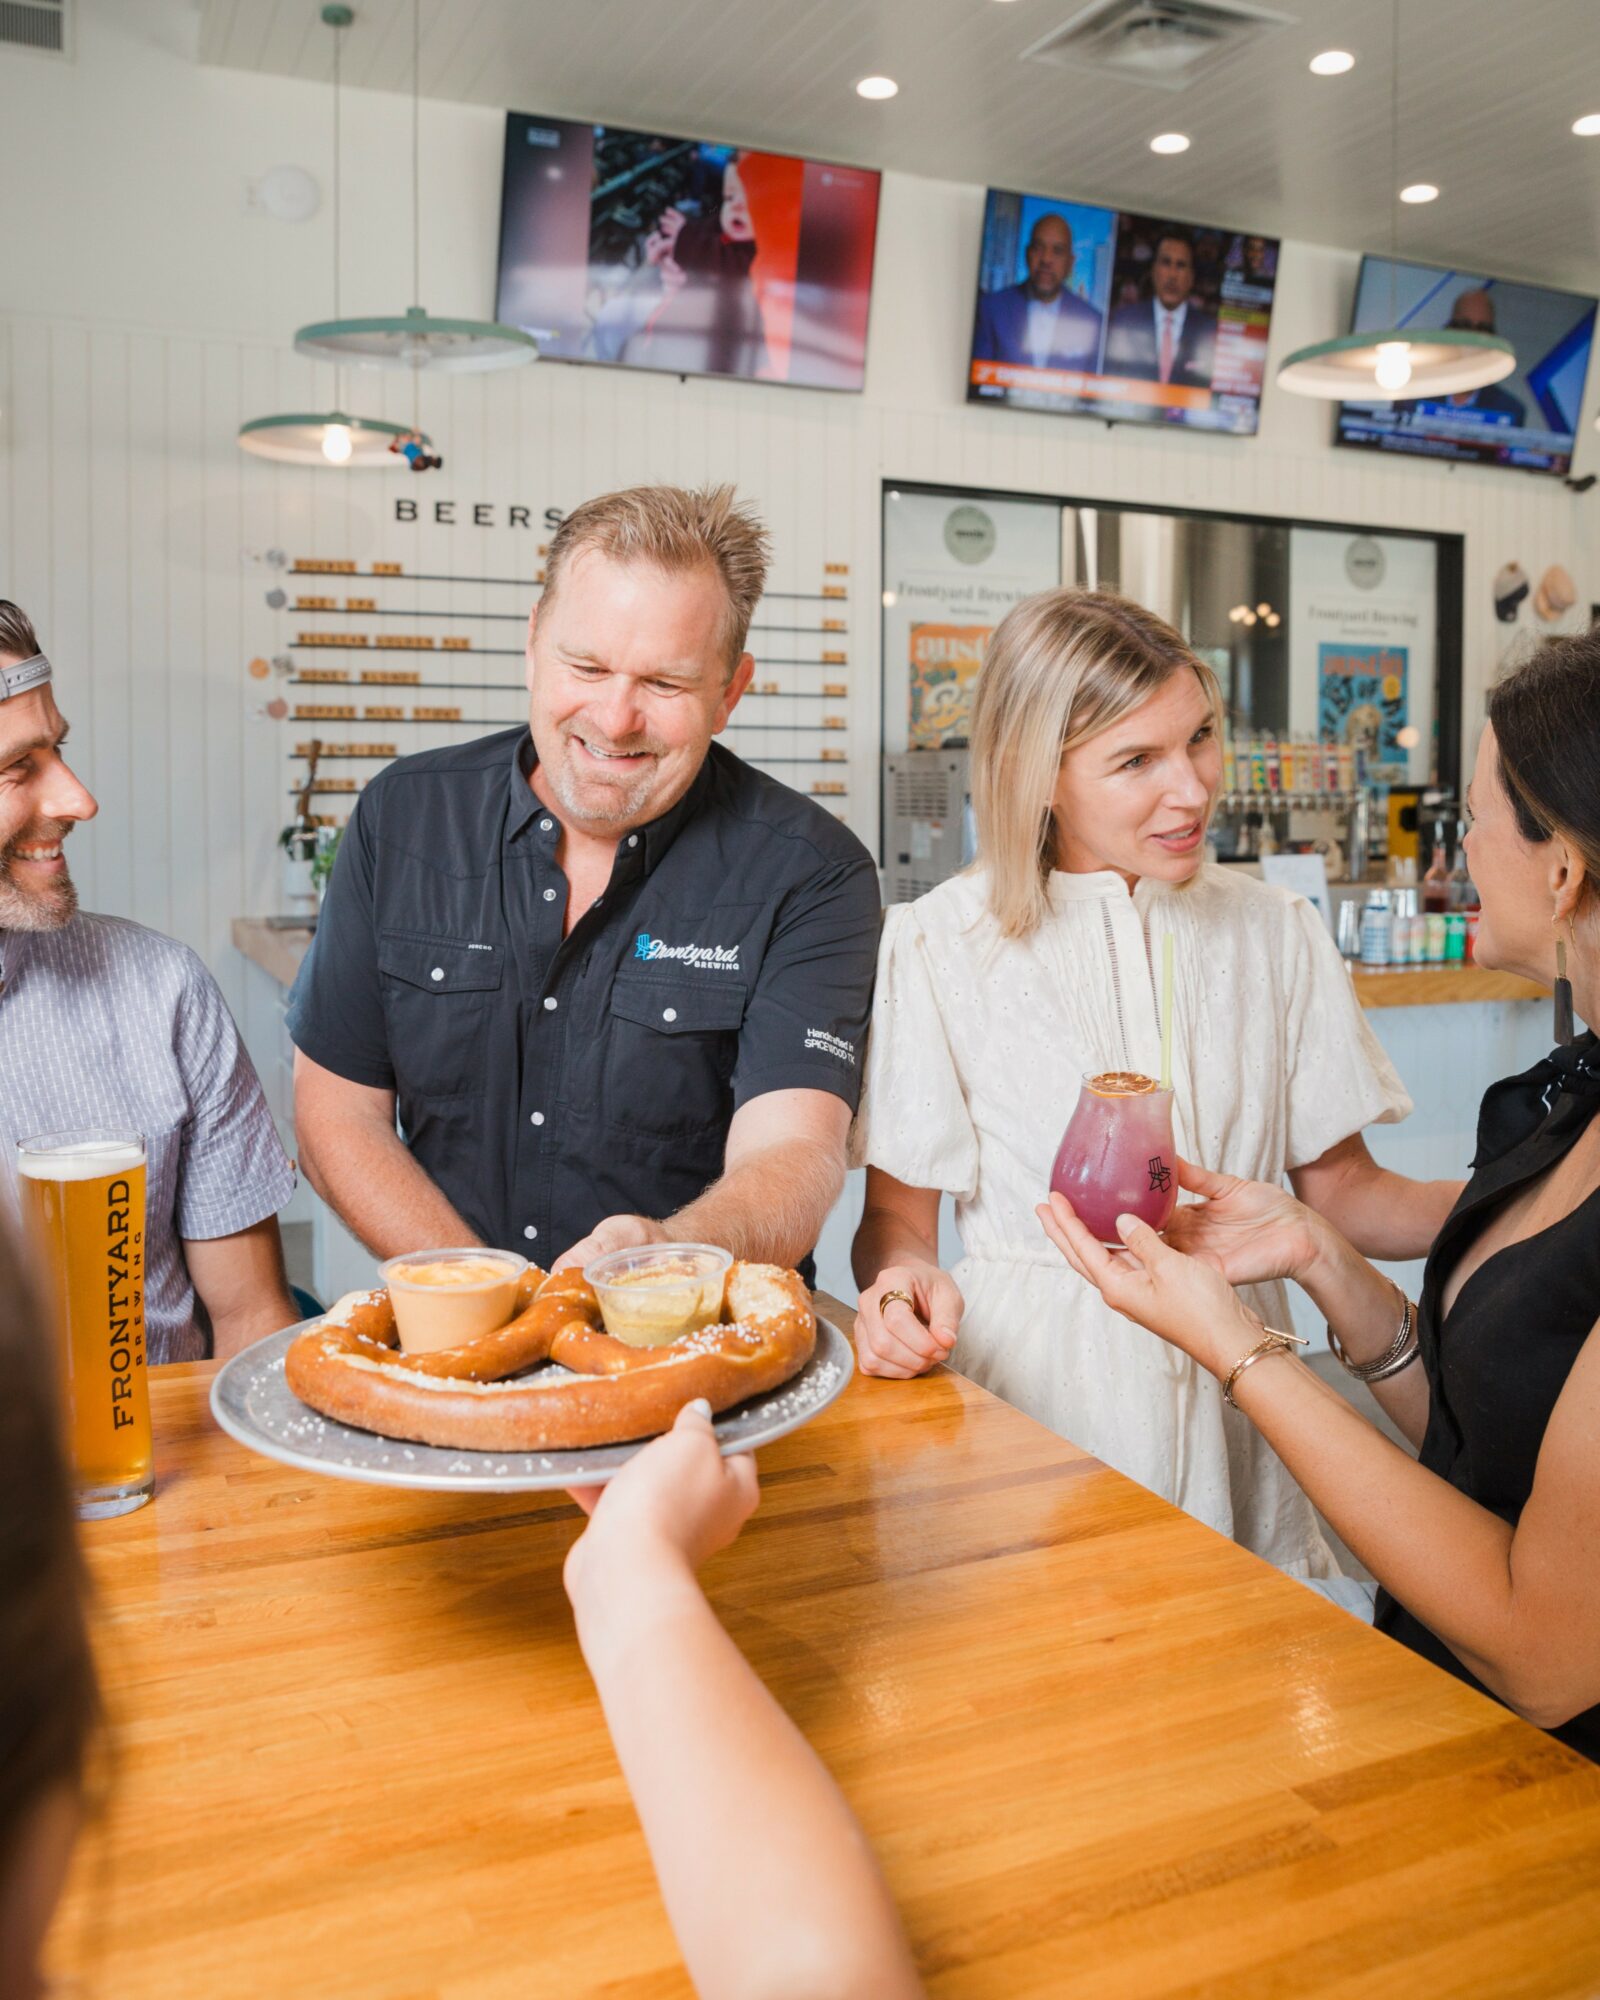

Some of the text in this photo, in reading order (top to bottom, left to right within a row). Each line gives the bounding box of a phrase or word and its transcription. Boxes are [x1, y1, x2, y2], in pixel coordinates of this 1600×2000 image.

[395, 499, 565, 530] BEERS
[647, 939, 740, 966] Frontyard
[693, 960, 740, 971] BREWING
[108, 1180, 134, 1430] FRONTYARD
[134, 1231, 143, 1366] BREWING
